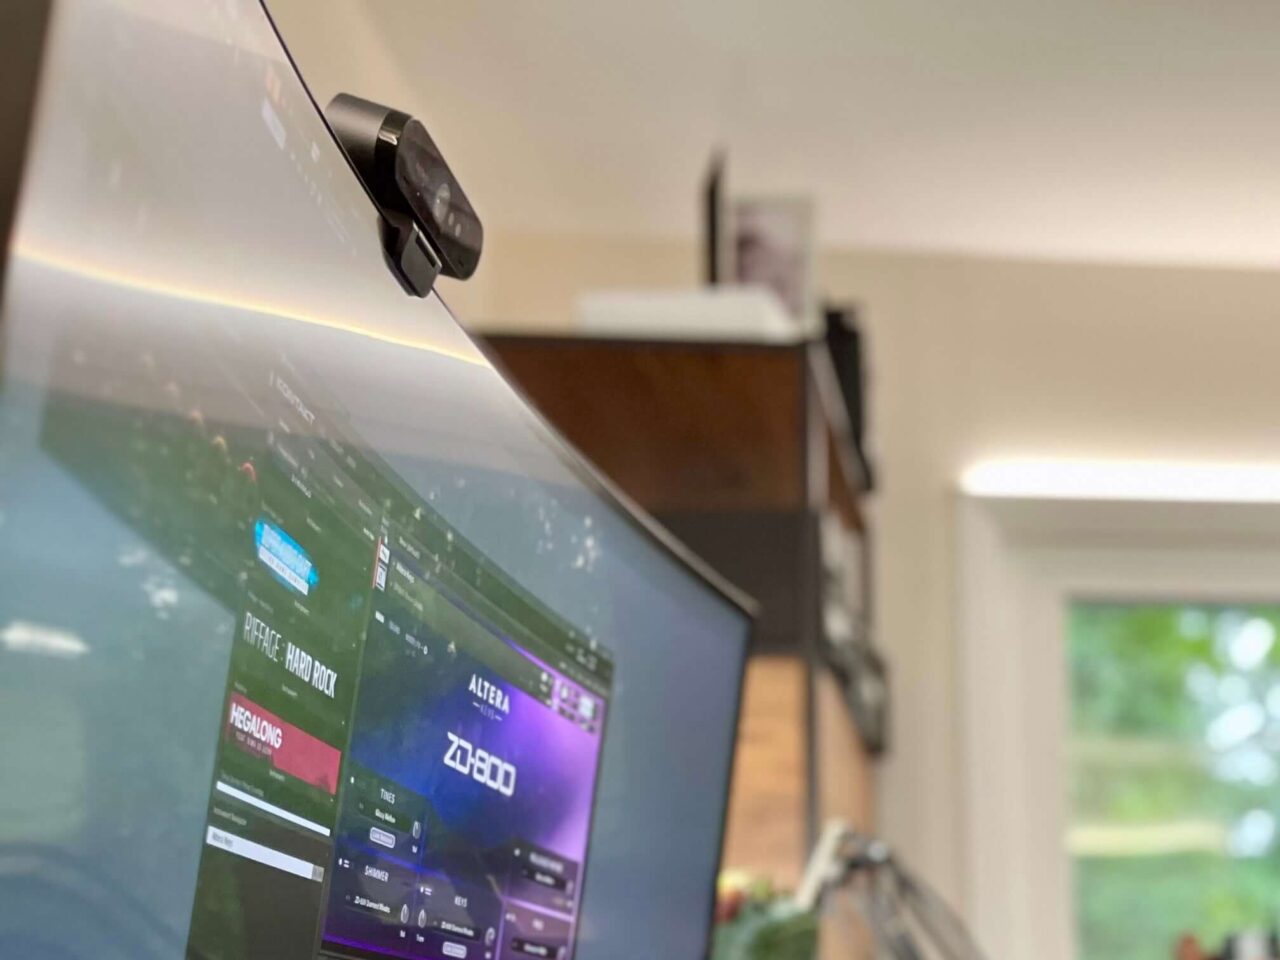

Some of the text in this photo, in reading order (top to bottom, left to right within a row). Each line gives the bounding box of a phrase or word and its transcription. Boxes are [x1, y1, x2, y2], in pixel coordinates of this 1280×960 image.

[285, 642, 313, 683] HARD
[311, 660, 338, 698] ROCK
[468, 673, 510, 714] ALTERA
